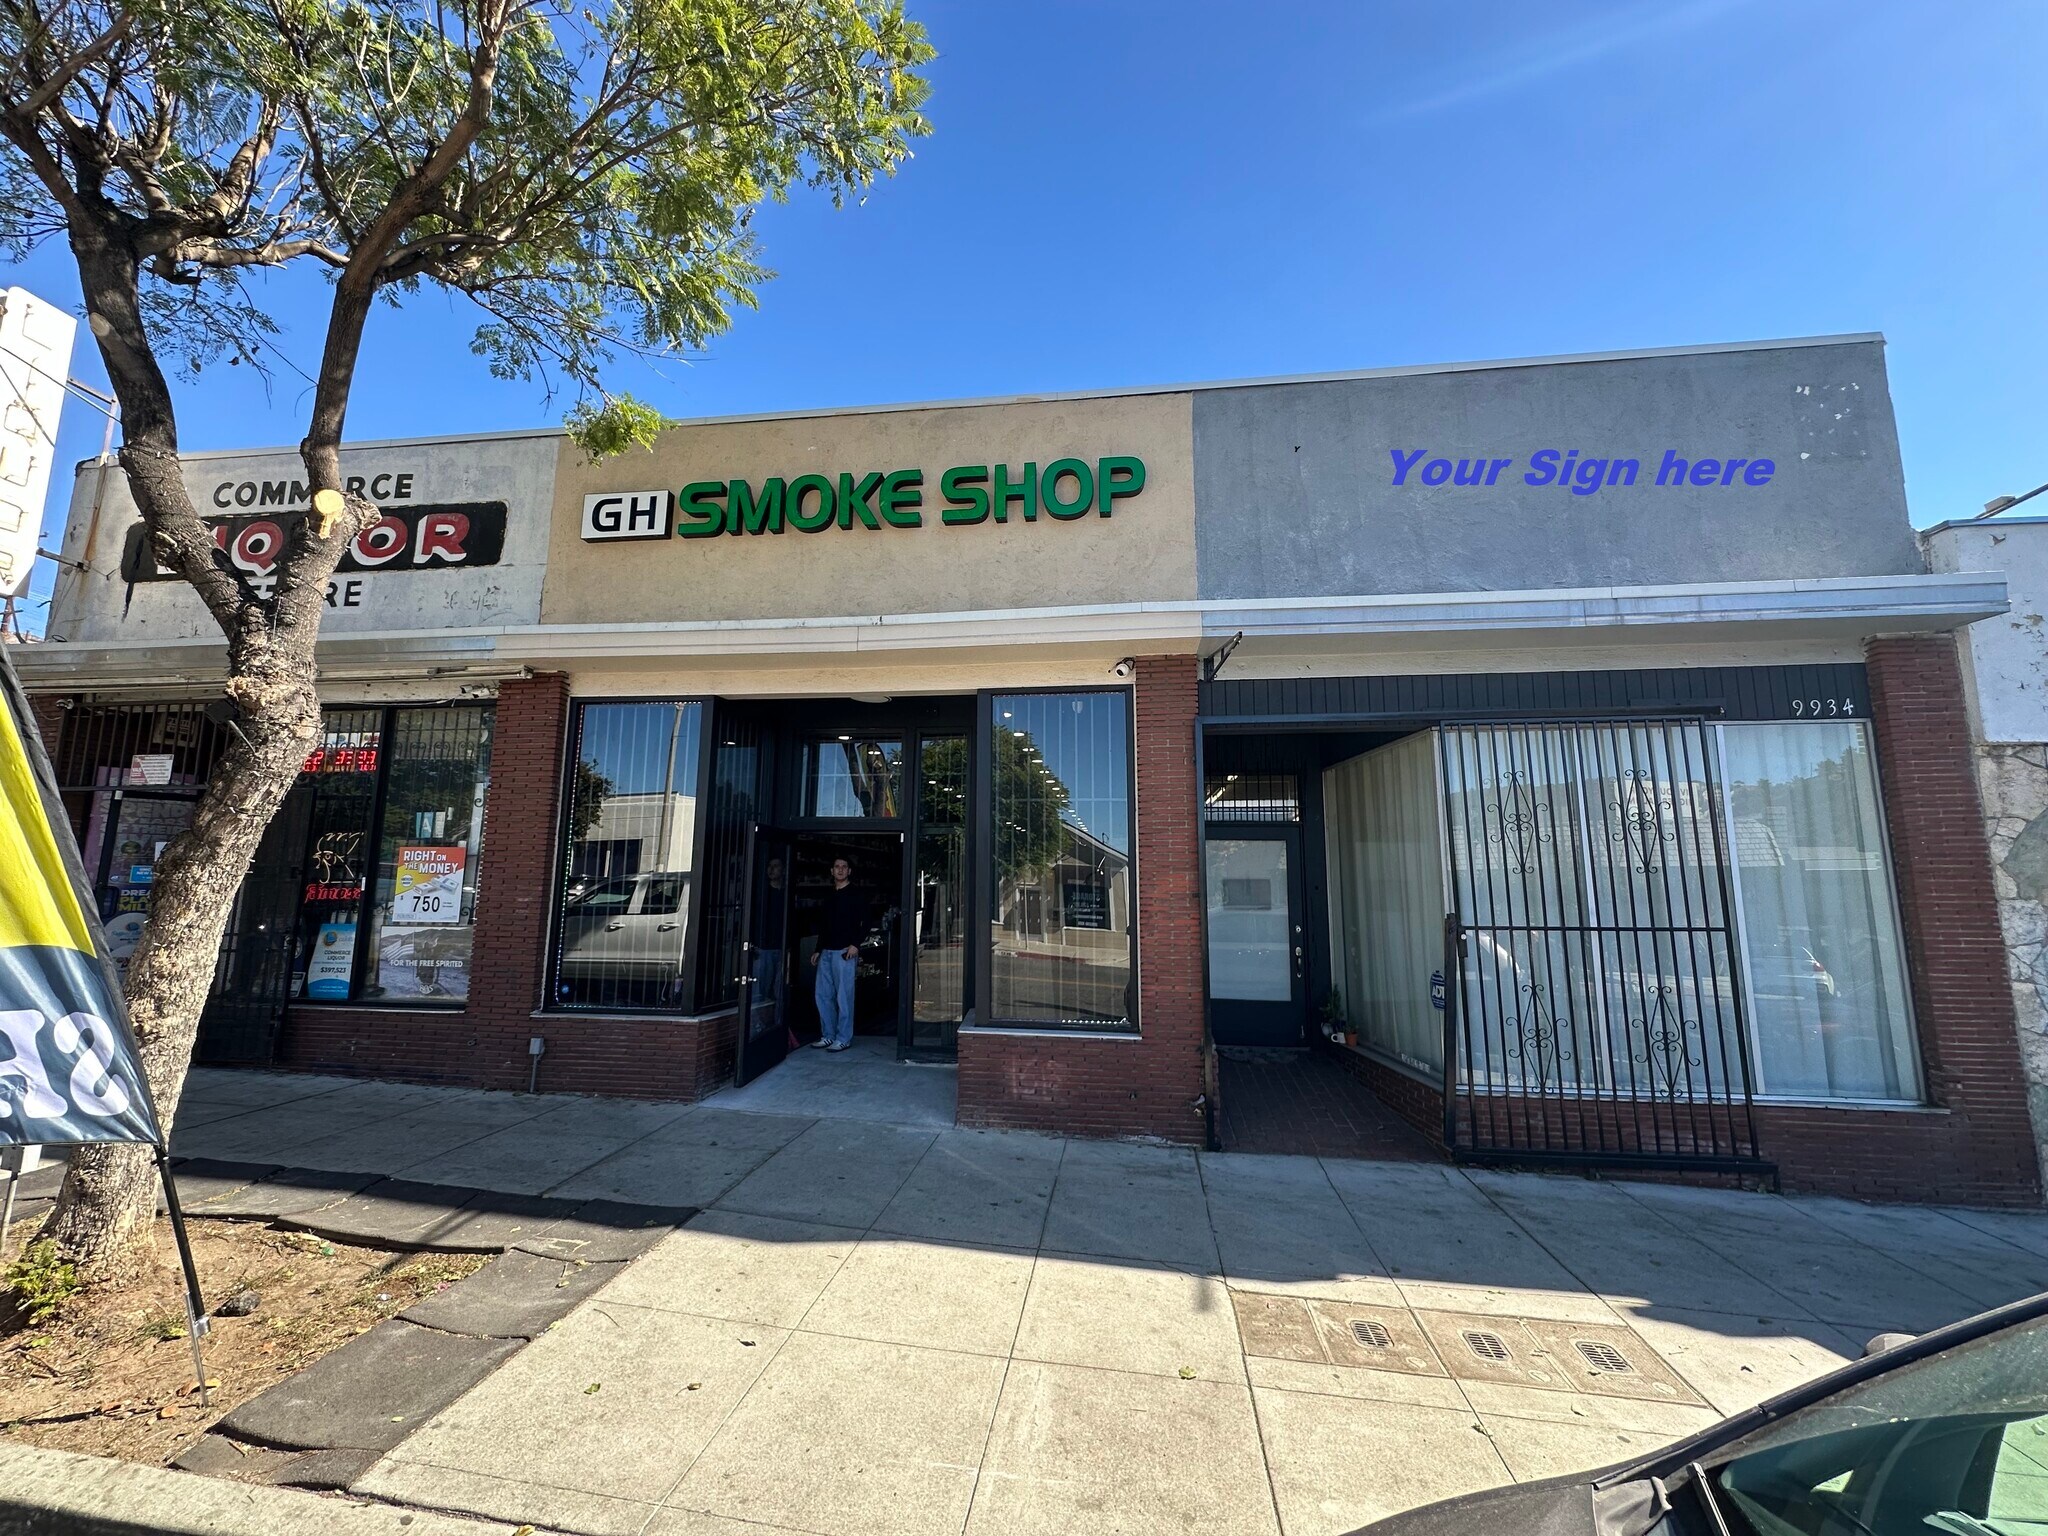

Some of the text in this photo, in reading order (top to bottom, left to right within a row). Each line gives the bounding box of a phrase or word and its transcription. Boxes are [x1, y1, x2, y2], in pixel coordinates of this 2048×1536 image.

[212, 473, 415, 508] COMMRCE
[591, 455, 1147, 538] GH SMOKE SHOP
[1792, 698, 1854, 716] 9934
[422, 818, 432, 833] A
[403, 850, 437, 862] RIGHT
[404, 862, 459, 874] THE MONEY
[413, 896, 441, 913] 750
[405, 959, 418, 967] THE
[435, 960, 464, 968] SPIRITED
